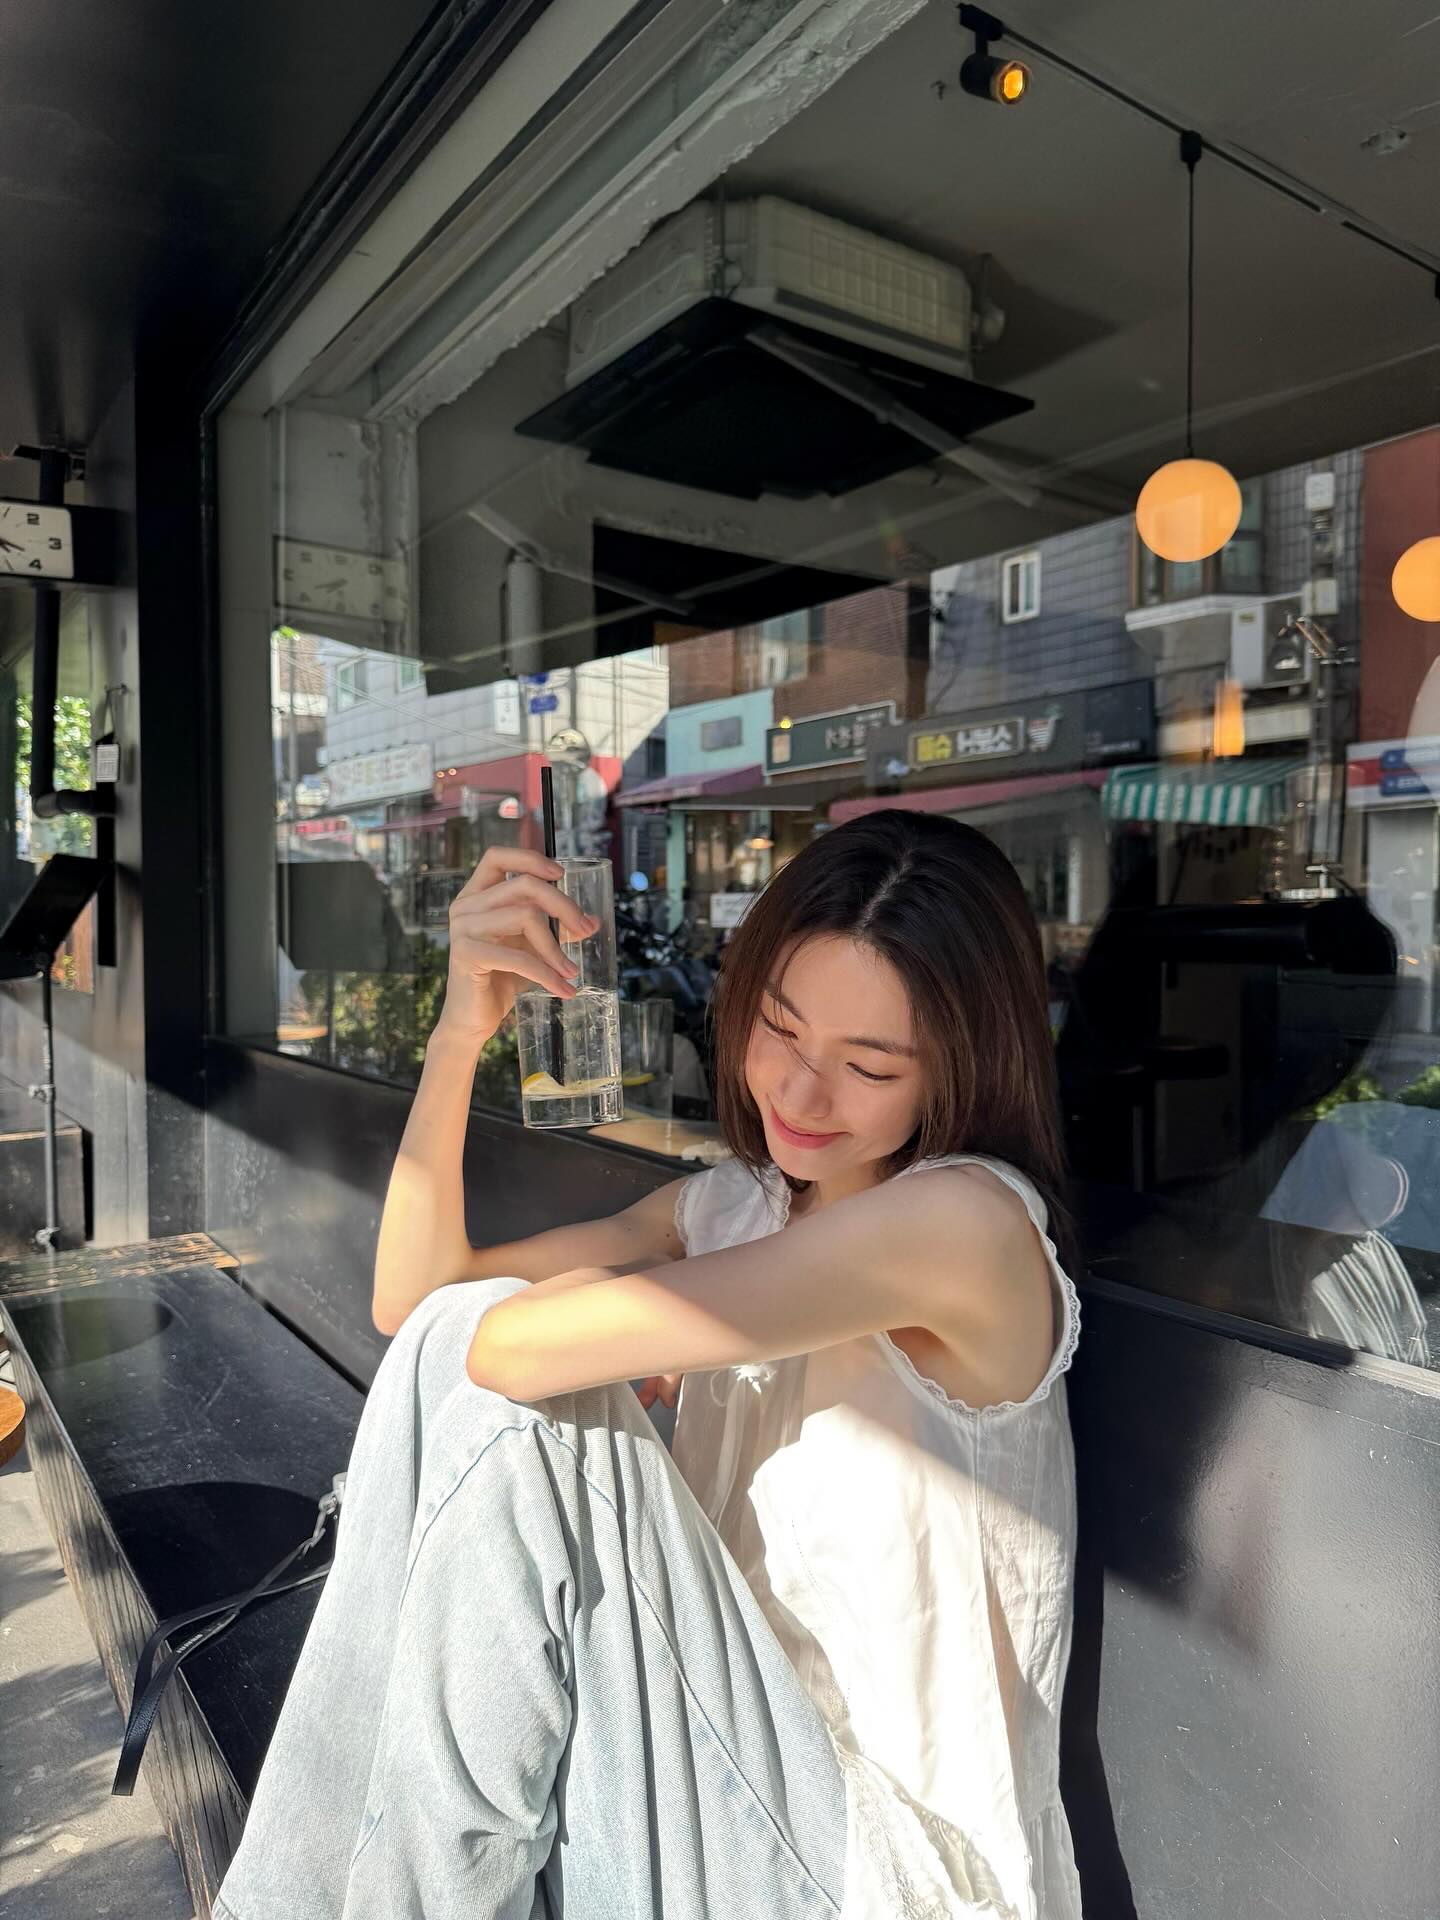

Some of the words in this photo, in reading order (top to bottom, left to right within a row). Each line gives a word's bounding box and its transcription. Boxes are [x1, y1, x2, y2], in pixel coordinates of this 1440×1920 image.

[26, 512, 40, 525] 2
[48, 537, 62, 550] 3
[28, 558, 42, 569] 4
